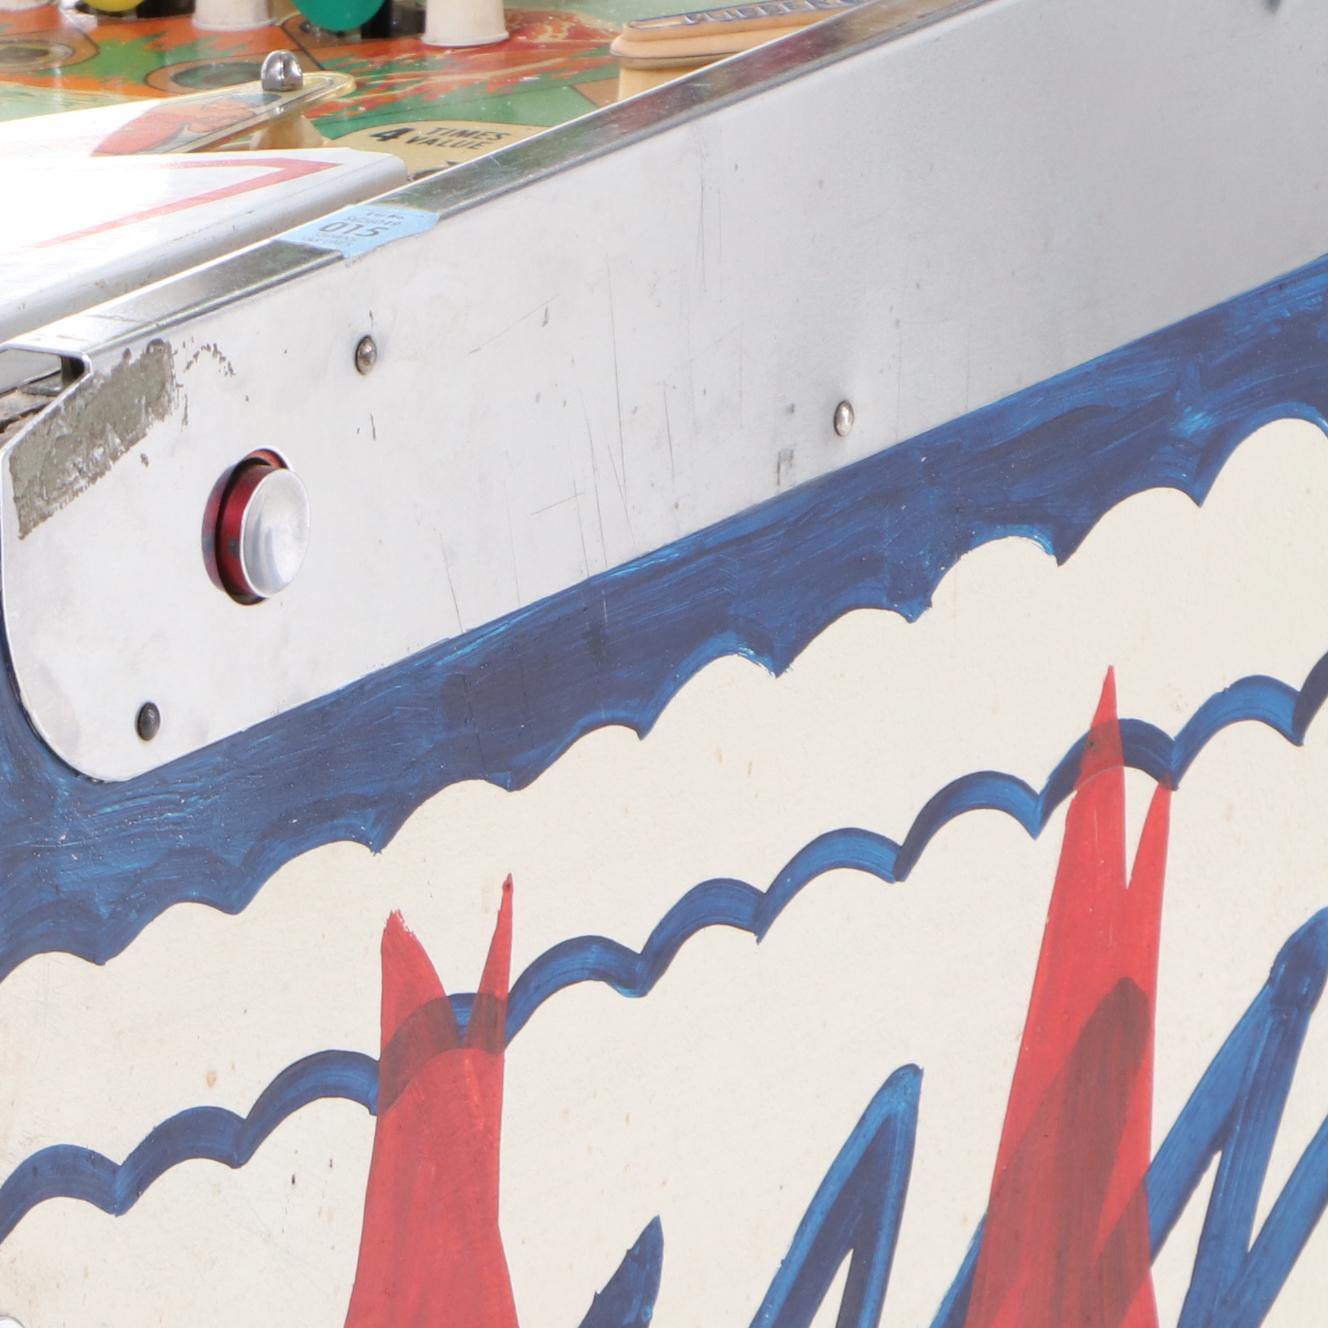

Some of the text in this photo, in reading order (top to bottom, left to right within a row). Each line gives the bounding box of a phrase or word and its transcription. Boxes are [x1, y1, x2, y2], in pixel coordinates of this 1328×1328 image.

[369, 127, 511, 142] 4 TIMES
[406, 135, 490, 150] VALUE
[319, 221, 389, 237] 015
